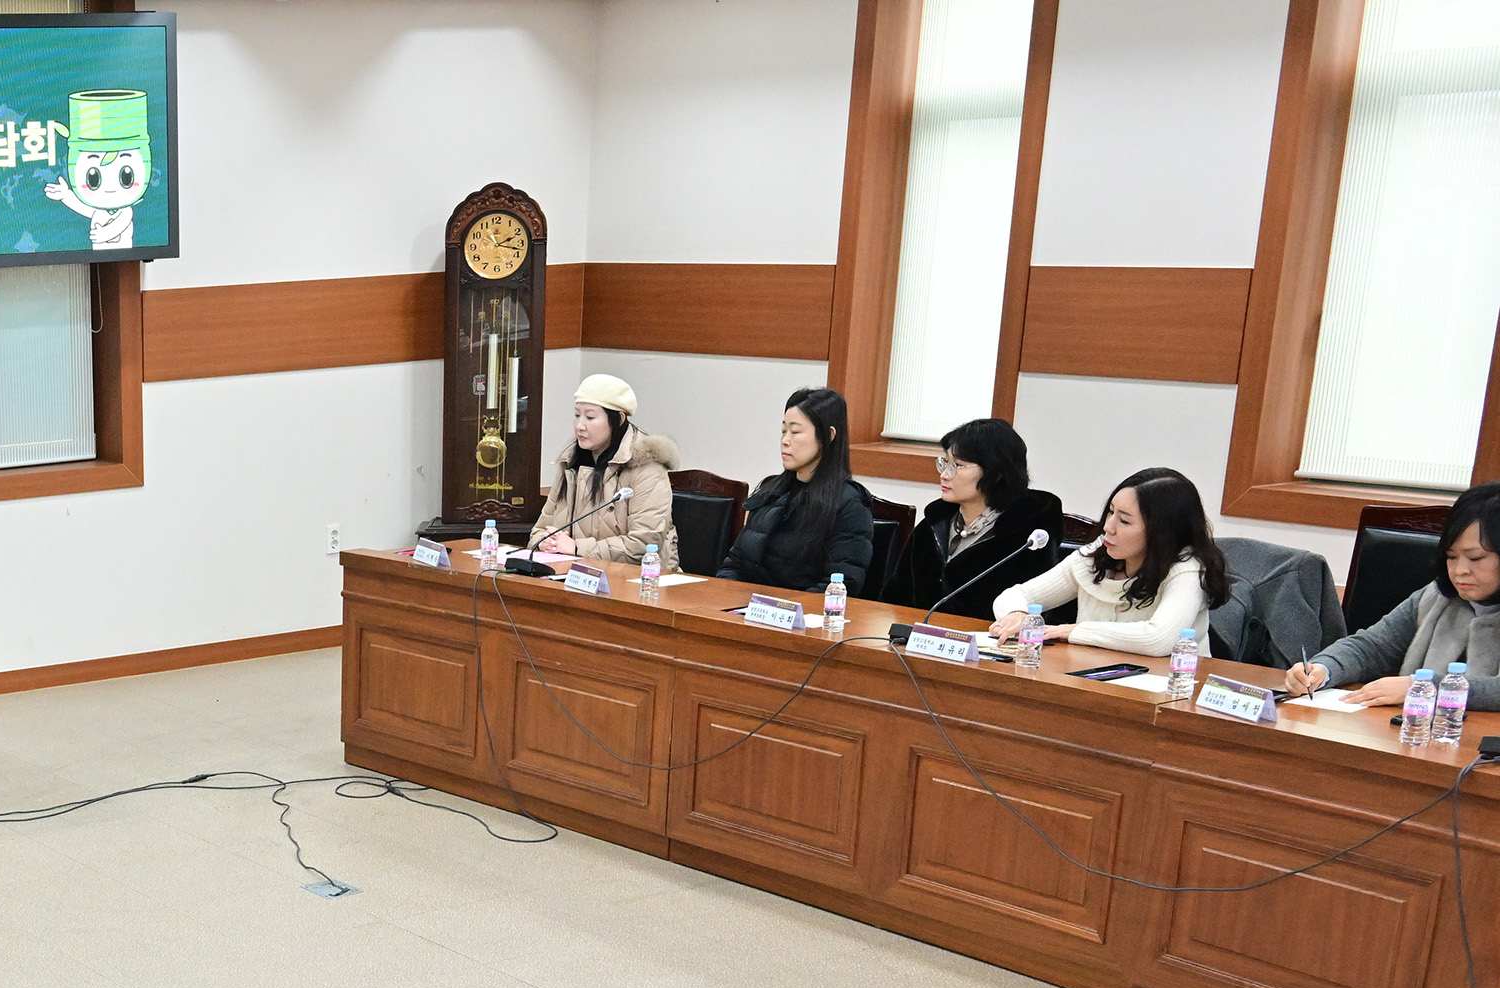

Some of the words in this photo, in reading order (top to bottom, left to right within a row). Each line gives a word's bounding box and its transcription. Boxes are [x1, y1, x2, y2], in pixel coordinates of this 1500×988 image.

[480, 221, 488, 229] 11
[492, 216, 502, 225] 12
[472, 231, 481, 240] 10
